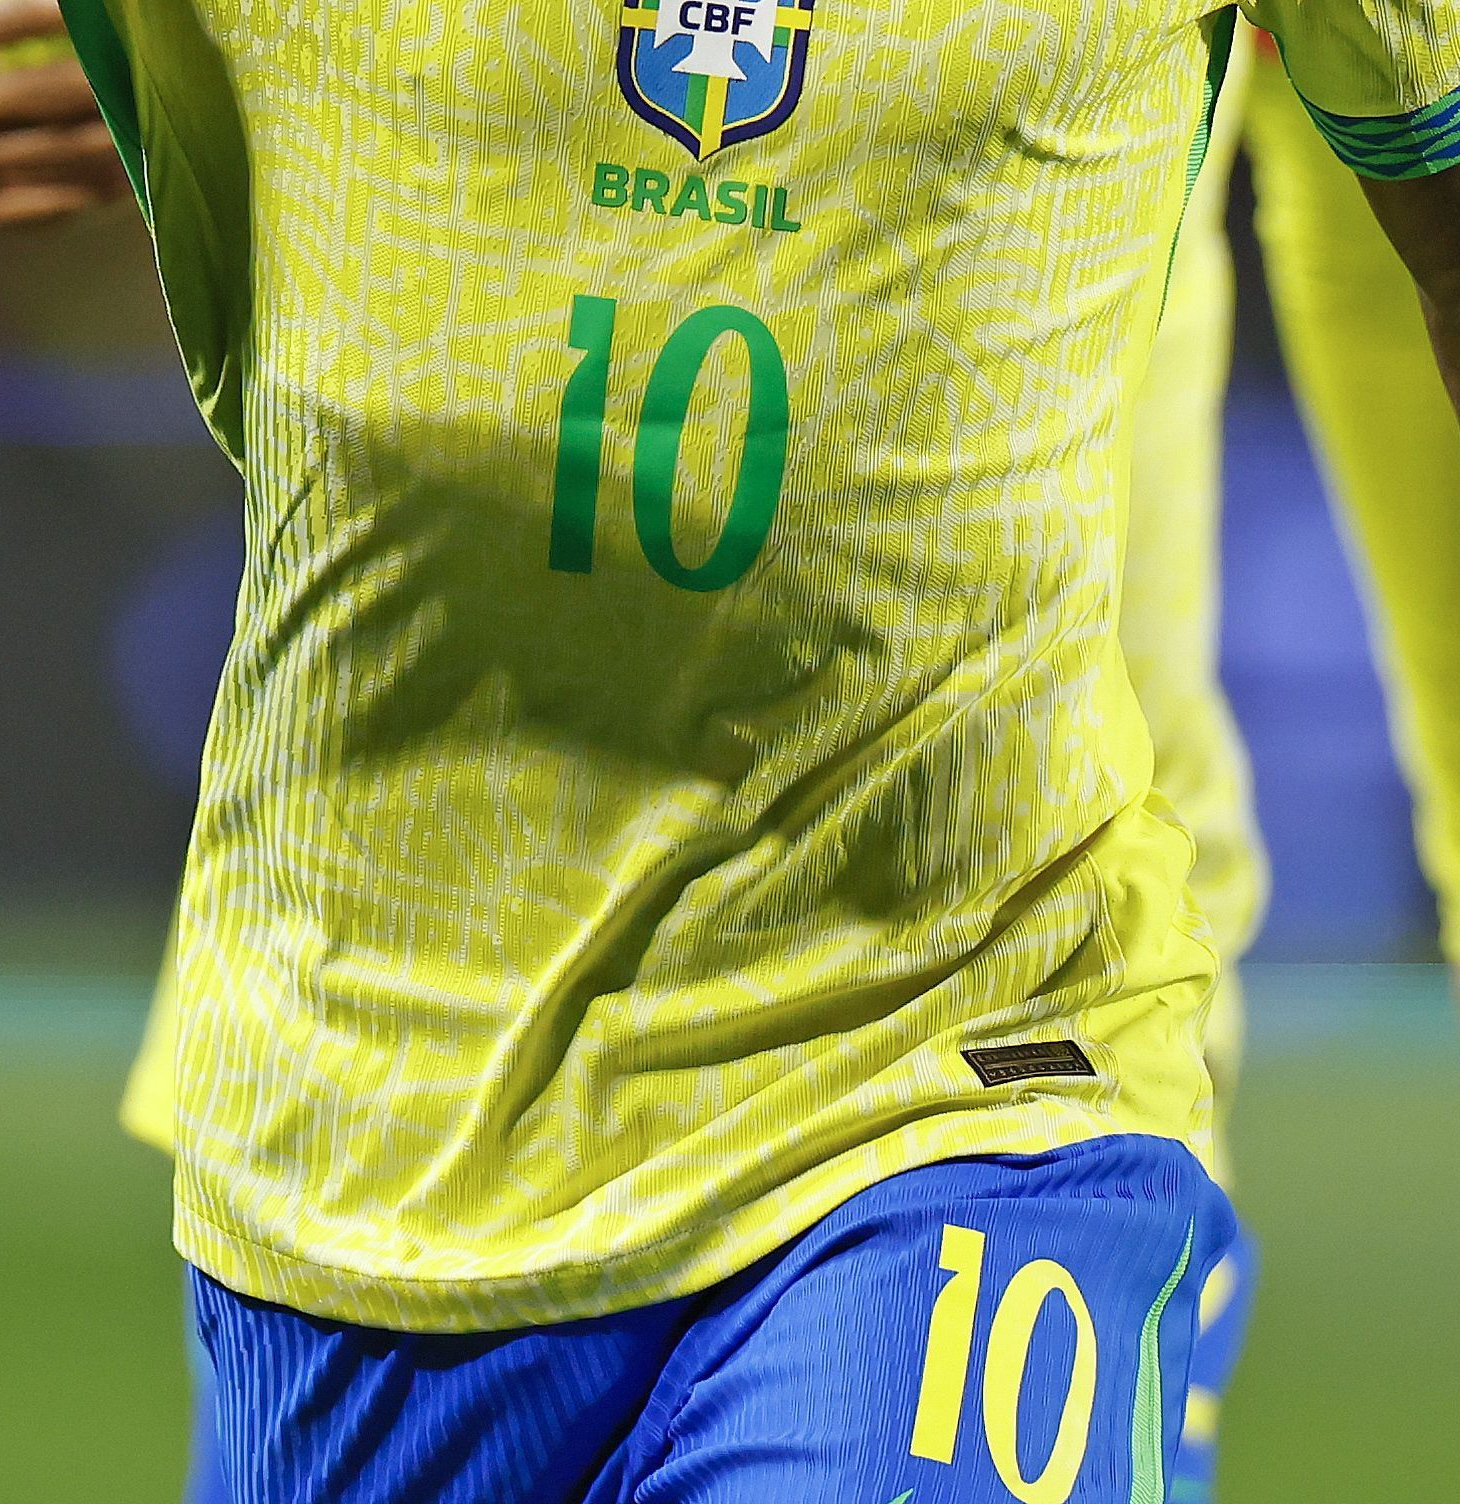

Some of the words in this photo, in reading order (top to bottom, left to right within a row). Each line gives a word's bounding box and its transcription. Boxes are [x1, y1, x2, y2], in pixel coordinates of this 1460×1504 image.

[679, 0, 756, 35] CBF
[592, 162, 801, 233] BRASIL
[549, 294, 790, 592] 10
[909, 1223, 1097, 1504] 10
